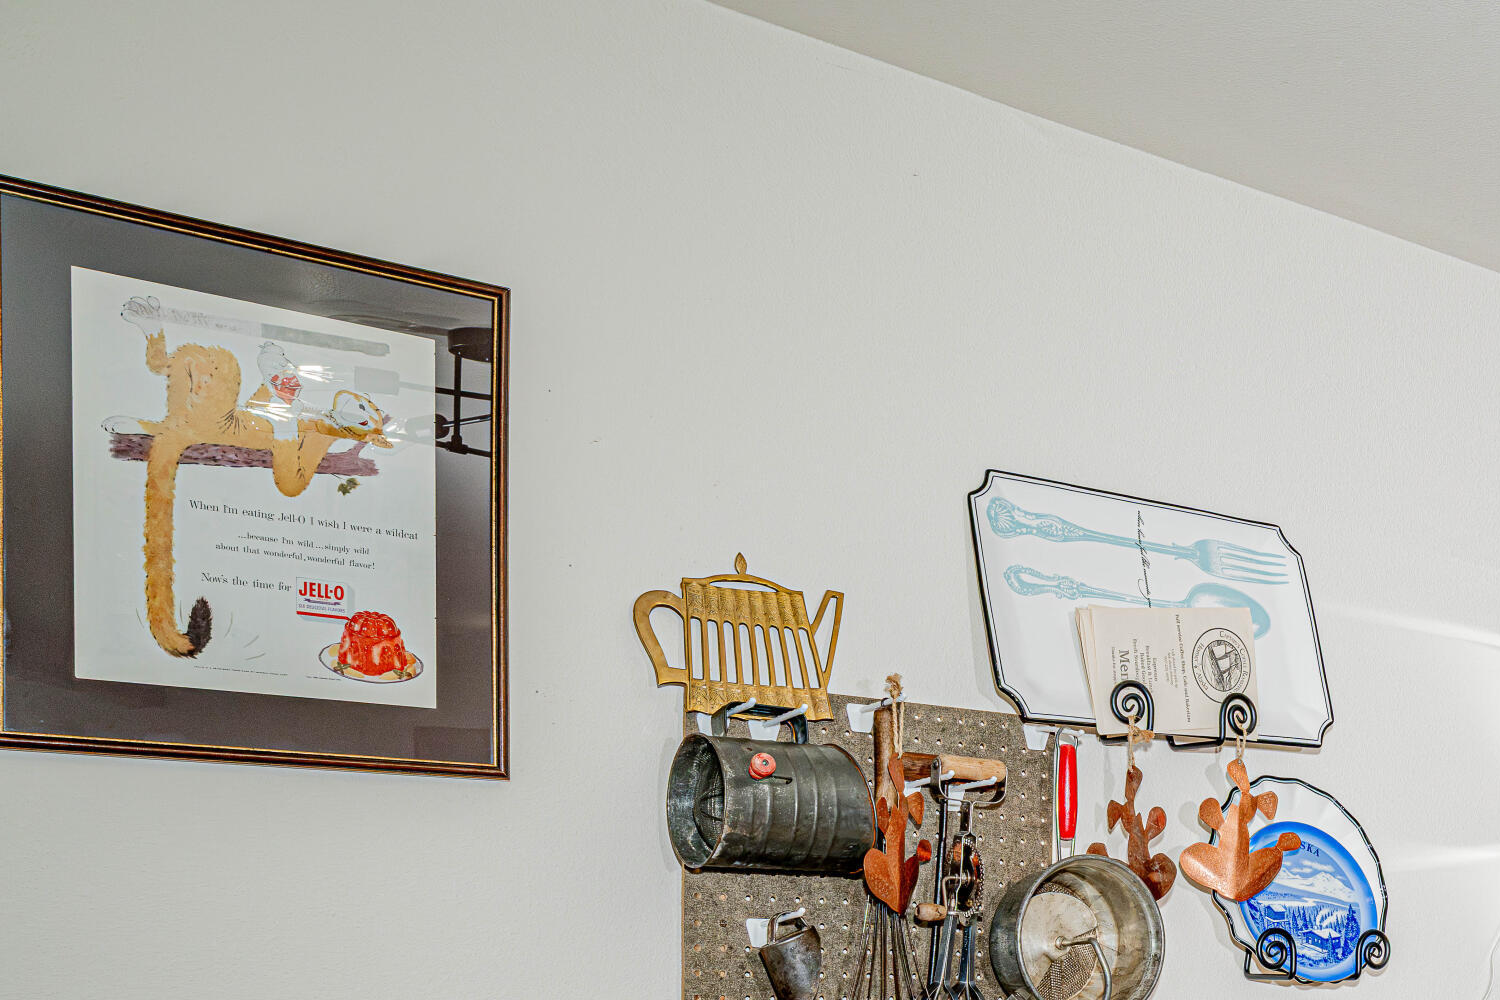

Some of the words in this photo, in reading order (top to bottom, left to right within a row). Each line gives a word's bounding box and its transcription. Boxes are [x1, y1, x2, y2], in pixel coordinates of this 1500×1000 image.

[188, 499, 219, 512] When
[223, 504, 238, 515] I'm
[242, 509, 275, 521] eating
[277, 512, 306, 524] Jell-O
[317, 519, 340, 529] wish
[350, 524, 373, 533] were
[385, 528, 418, 540] wildcat
[215, 542, 239, 552] about
[243, 545, 260, 555] that
[349, 560, 376, 570] flavor!
[201, 572, 228, 584] Now's
[232, 576, 248, 586] the
[252, 579, 275, 590] time
[278, 581, 292, 592] for
[1118, 649, 1130, 681] Men
[1300, 840, 1320, 858] SKA
